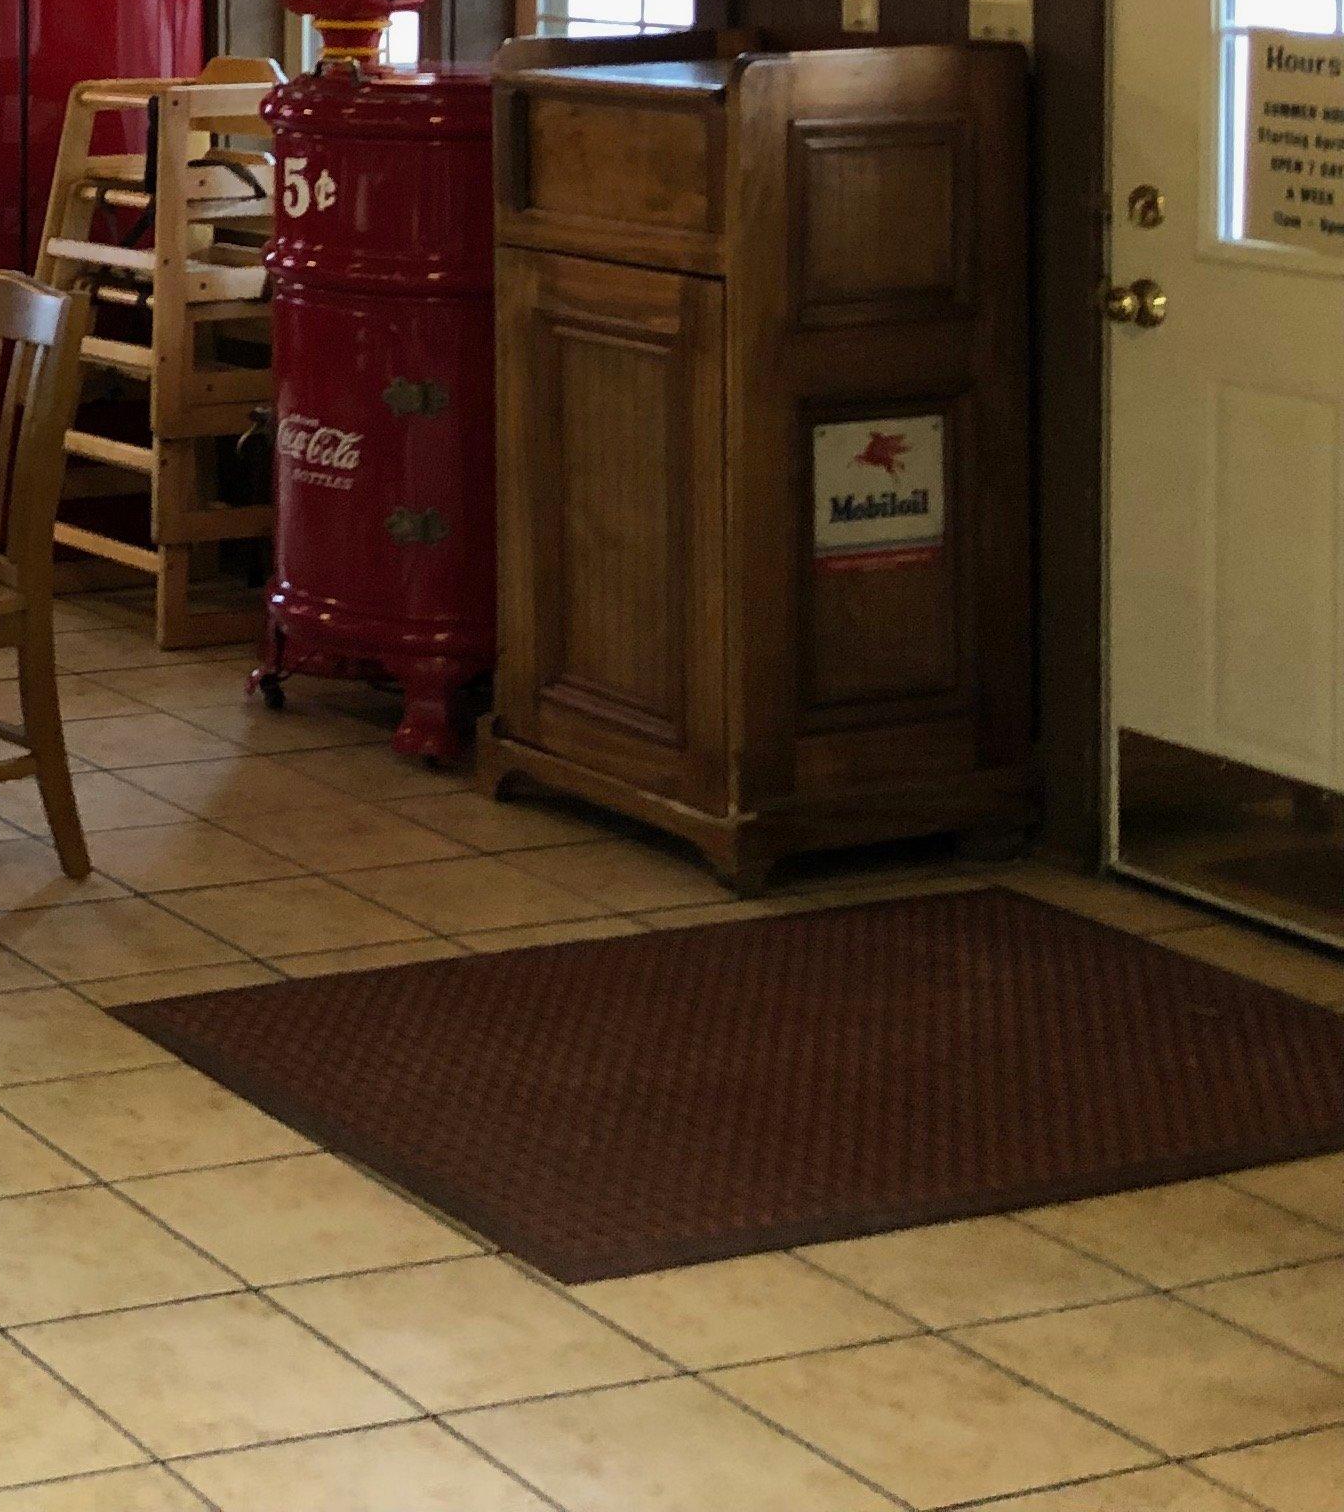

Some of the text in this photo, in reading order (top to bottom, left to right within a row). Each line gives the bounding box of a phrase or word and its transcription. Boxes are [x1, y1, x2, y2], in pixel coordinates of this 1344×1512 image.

[1266, 43, 1341, 78] Hours
[283, 157, 336, 218] 5¢
[1300, 187, 1334, 206] WEEK
[829, 488, 930, 525] Mobiloil
